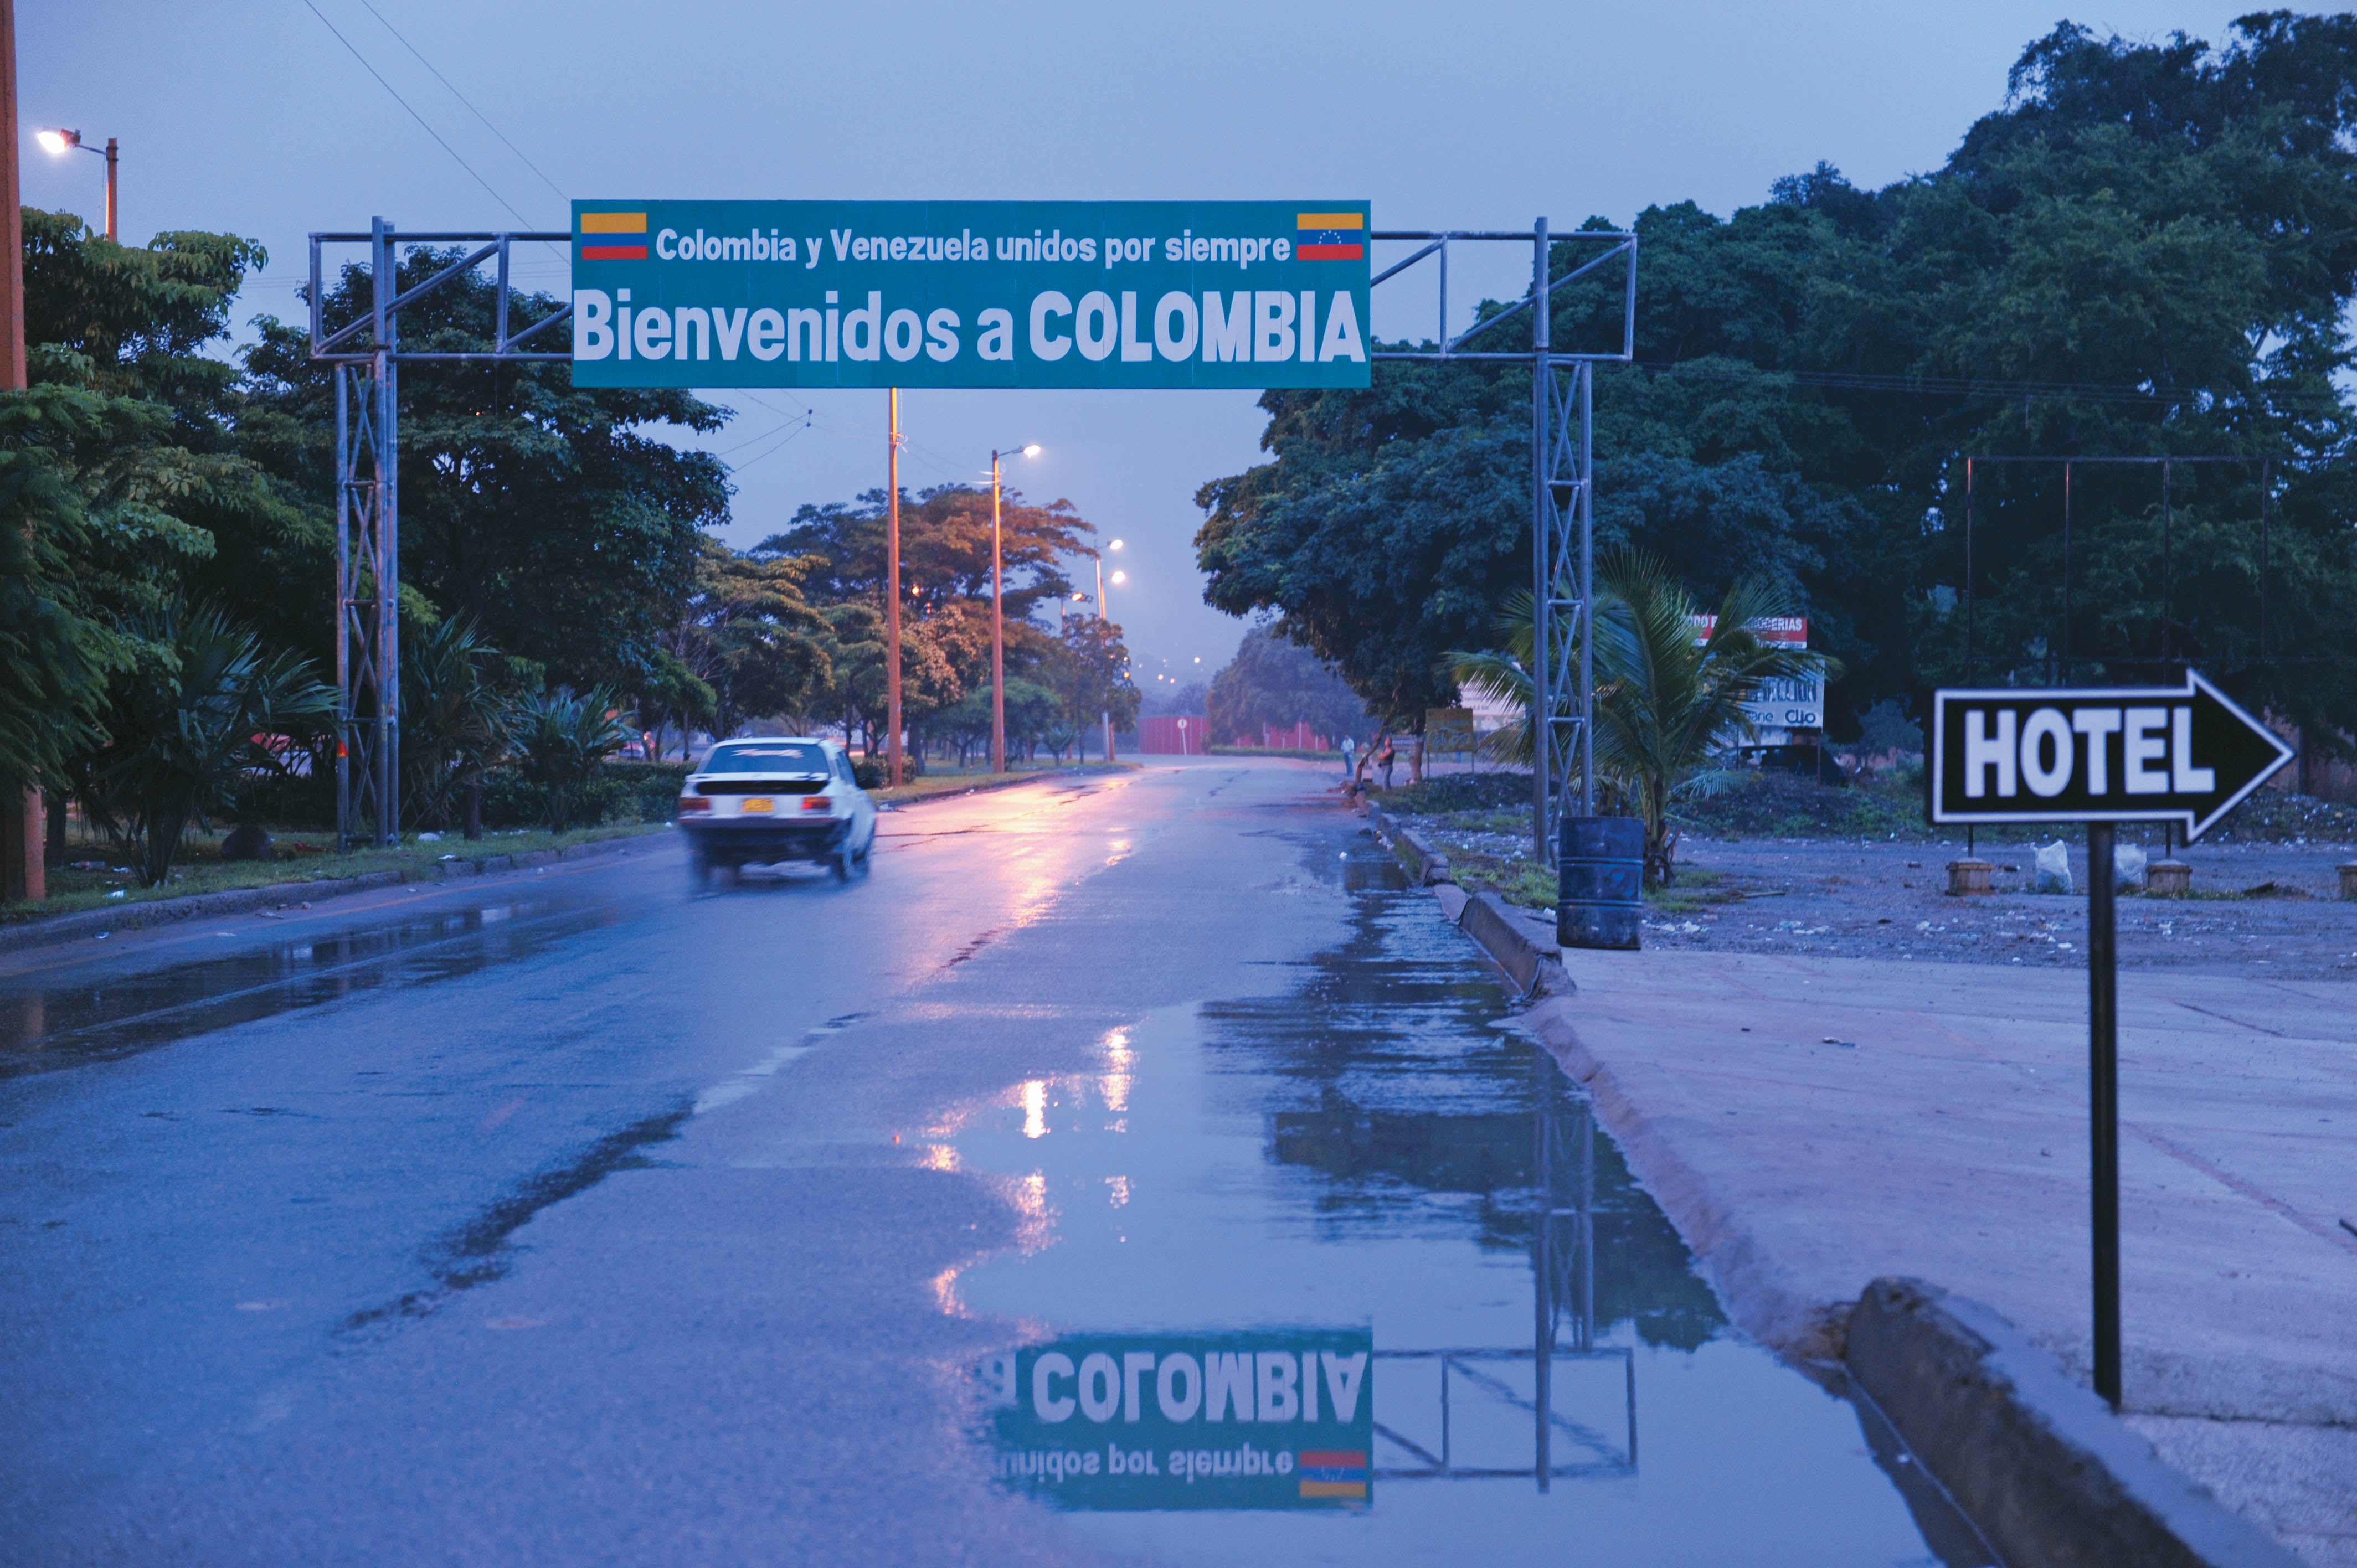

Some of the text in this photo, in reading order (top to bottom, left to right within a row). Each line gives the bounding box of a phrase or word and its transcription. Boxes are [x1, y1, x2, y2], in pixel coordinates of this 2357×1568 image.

[657, 228, 1290, 270] Colombia y Venezuela unidos por siempre
[574, 288, 1366, 362] Bienvenidos a COLOMBIA
[1965, 706, 2215, 798] HOTEL
